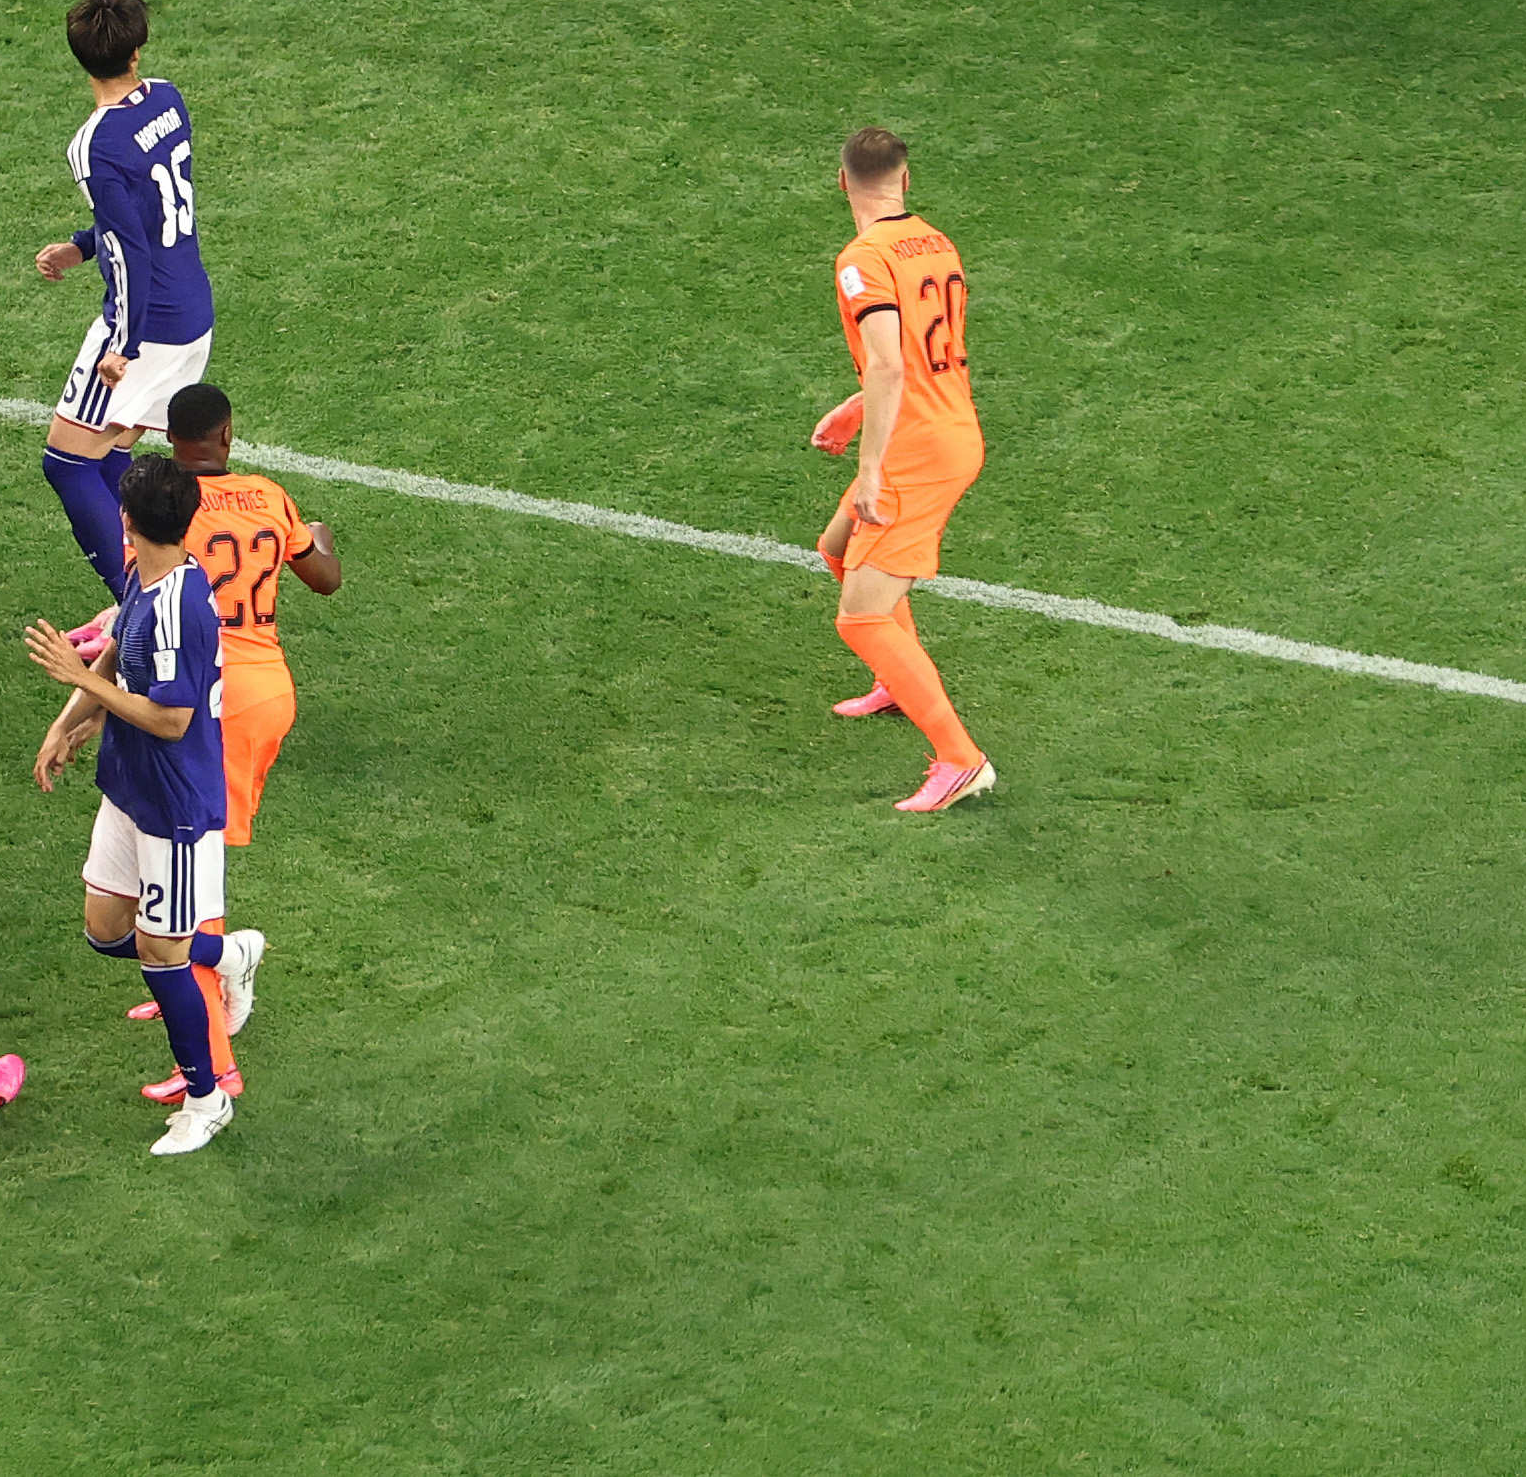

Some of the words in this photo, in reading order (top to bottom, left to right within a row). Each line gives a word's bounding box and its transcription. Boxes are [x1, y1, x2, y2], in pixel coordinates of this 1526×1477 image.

[150, 140, 193, 248] 15
[920, 270, 968, 375] 20
[204, 526, 280, 629] 22
[138, 877, 165, 924] 2
